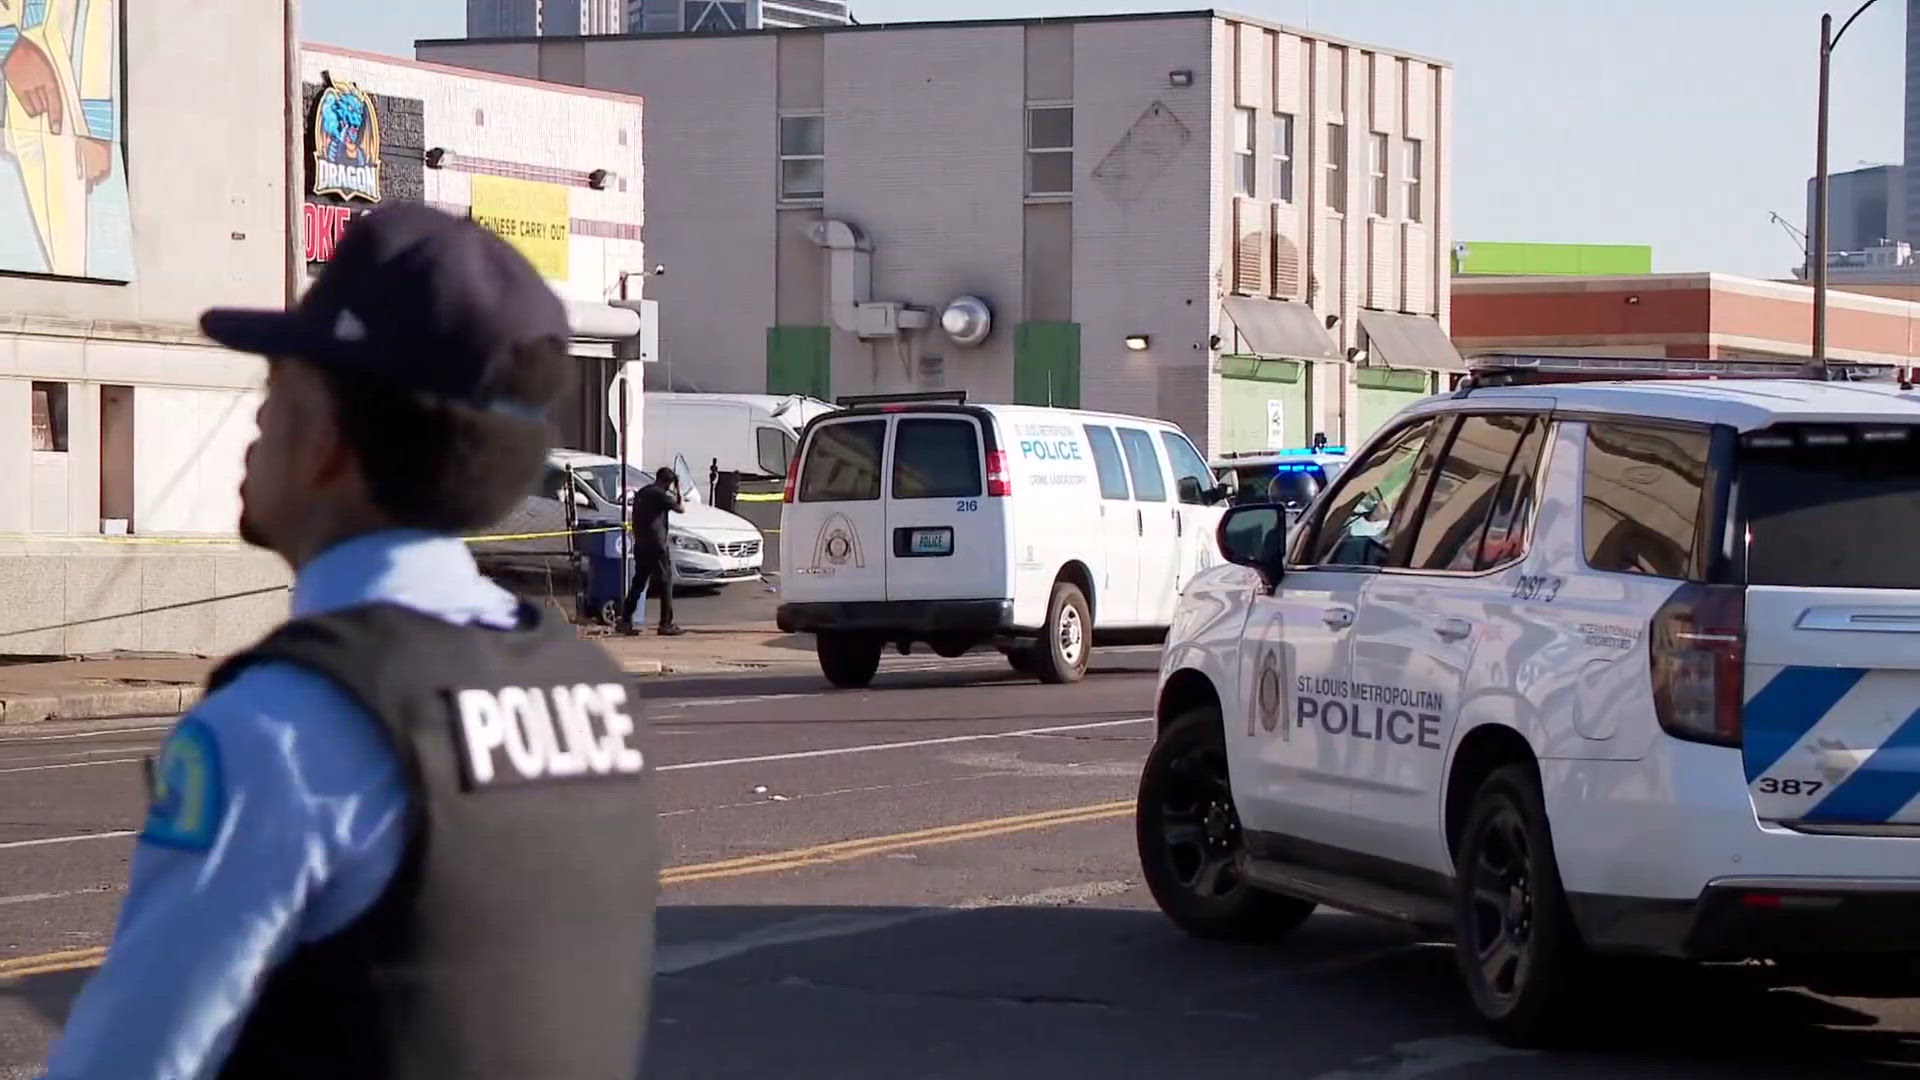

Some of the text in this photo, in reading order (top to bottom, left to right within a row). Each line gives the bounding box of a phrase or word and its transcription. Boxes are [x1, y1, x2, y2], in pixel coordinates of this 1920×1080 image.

[319, 160, 378, 198] DRAGON
[520, 220, 547, 239] CARRY
[550, 223, 565, 241] OUT
[1020, 440, 1082, 460] POLICE
[956, 500, 978, 512] 216
[919, 535, 943, 548] POLICE
[1545, 579, 1561, 603] 3
[1297, 675, 1443, 711] ST. LOUIS METROPOLITAN
[458, 682, 644, 784] POLICE
[1297, 696, 1441, 750] POLICE
[1759, 777, 1824, 796] 387
